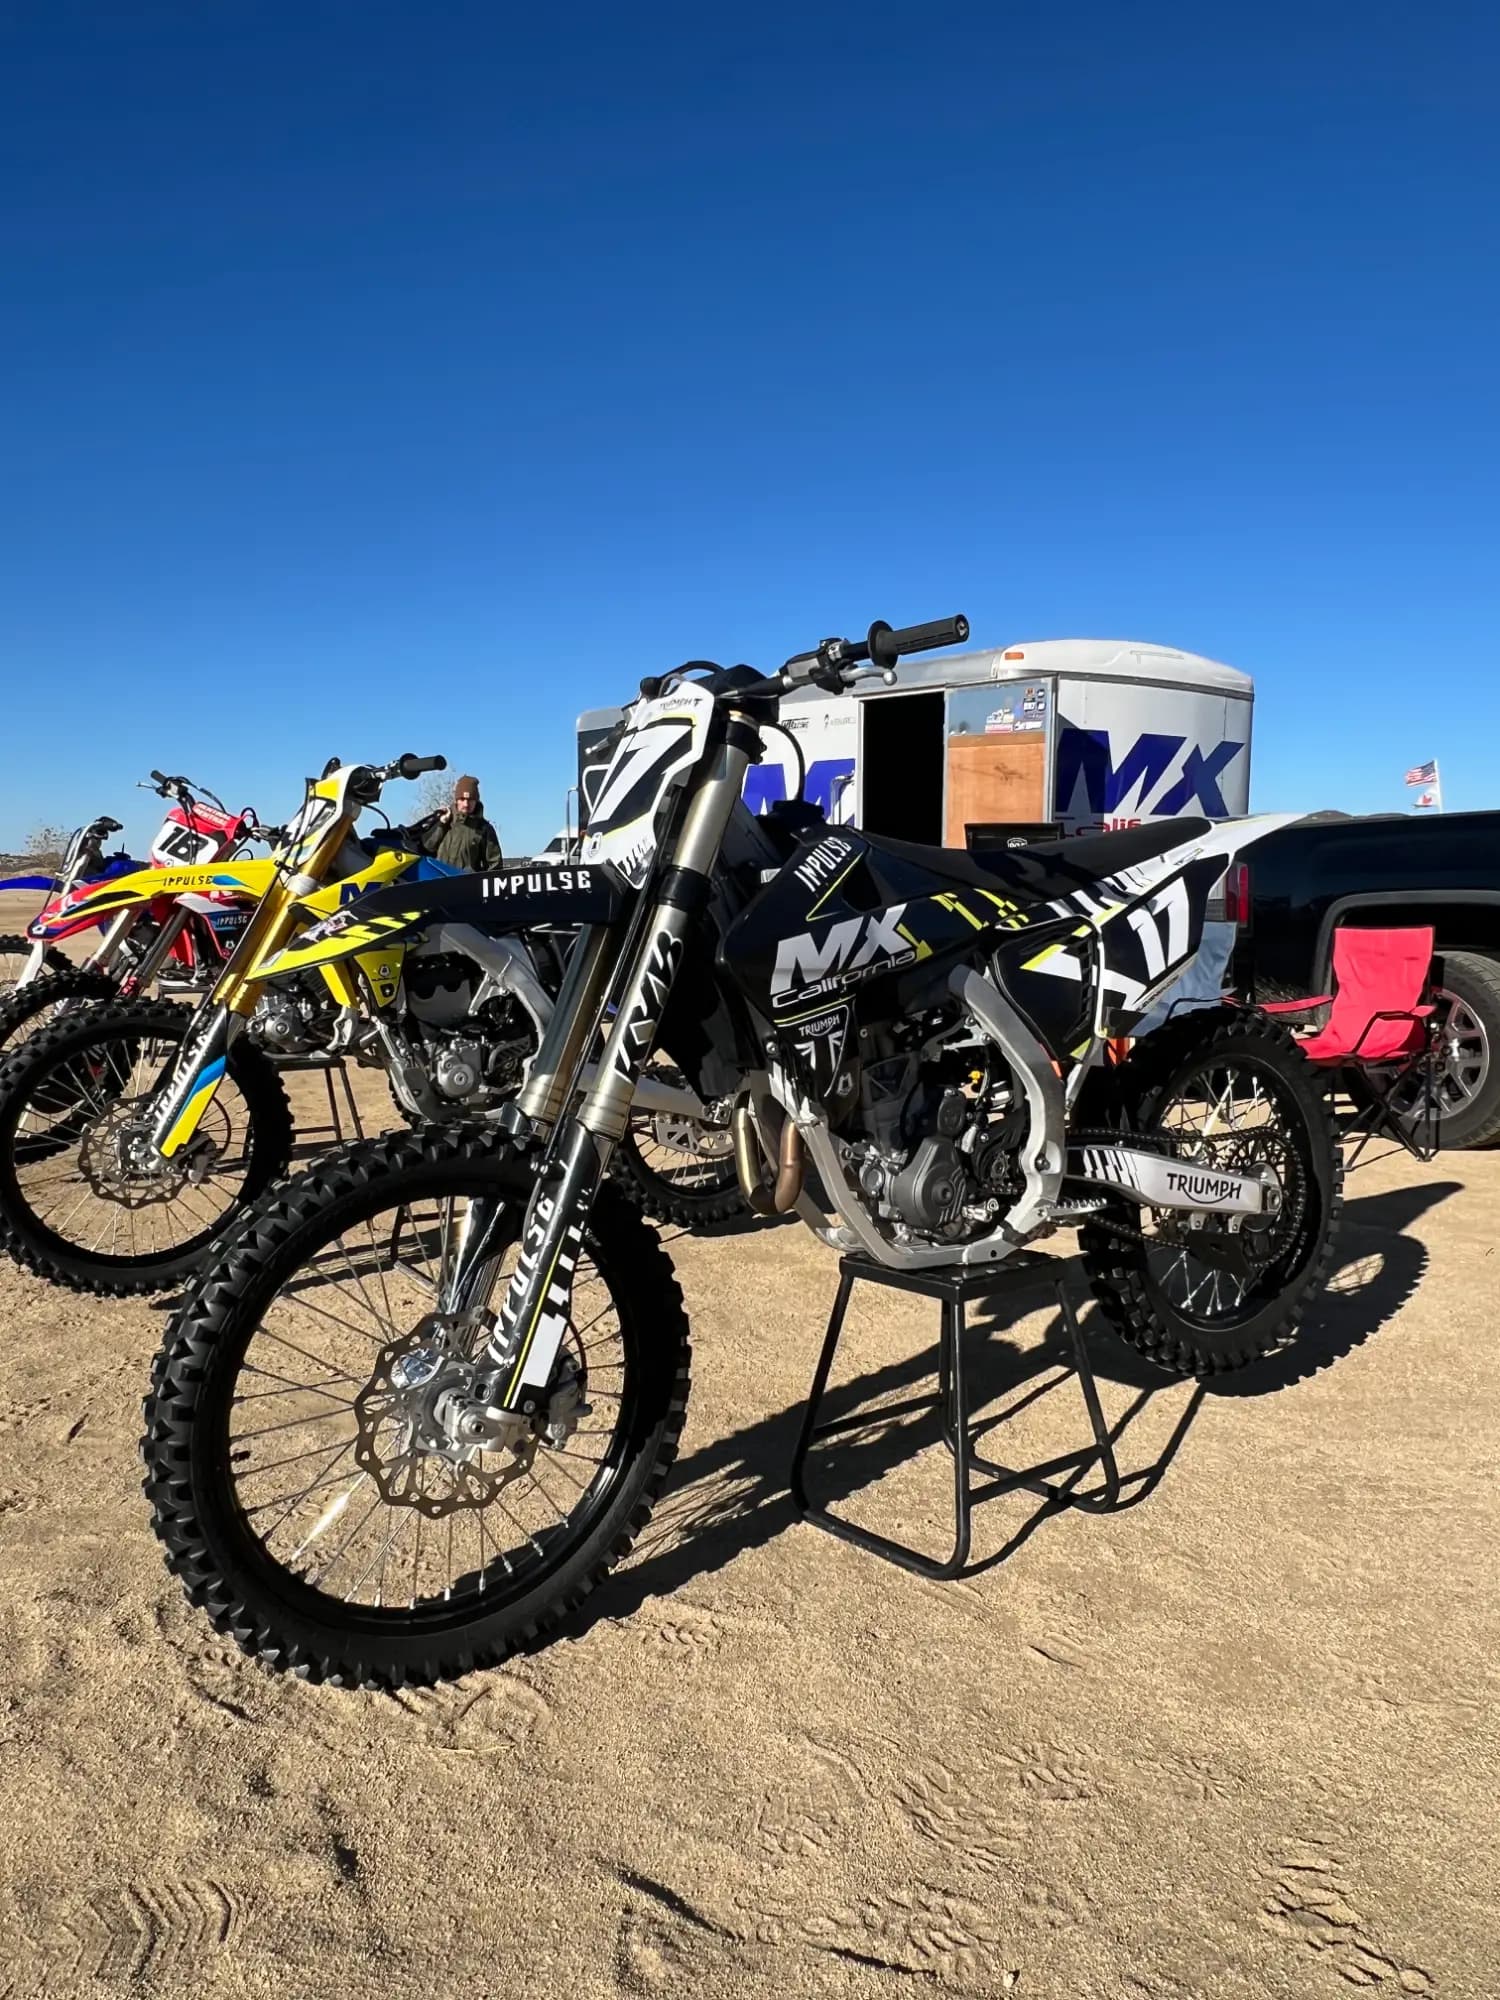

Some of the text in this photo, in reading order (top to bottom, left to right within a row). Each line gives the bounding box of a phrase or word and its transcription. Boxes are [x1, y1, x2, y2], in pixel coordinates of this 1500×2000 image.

[1055, 728, 1245, 817] MX
[482, 870, 592, 898] IMPULSE
[793, 836, 852, 892] IMPULSE
[770, 902, 913, 996] MX
[1127, 876, 1190, 981] 17
[772, 950, 916, 1009] California
[798, 1013, 841, 1037] TRIUMPH
[1166, 1172, 1242, 1204] TRIUMPH
[488, 1192, 556, 1366] IMPULSE
